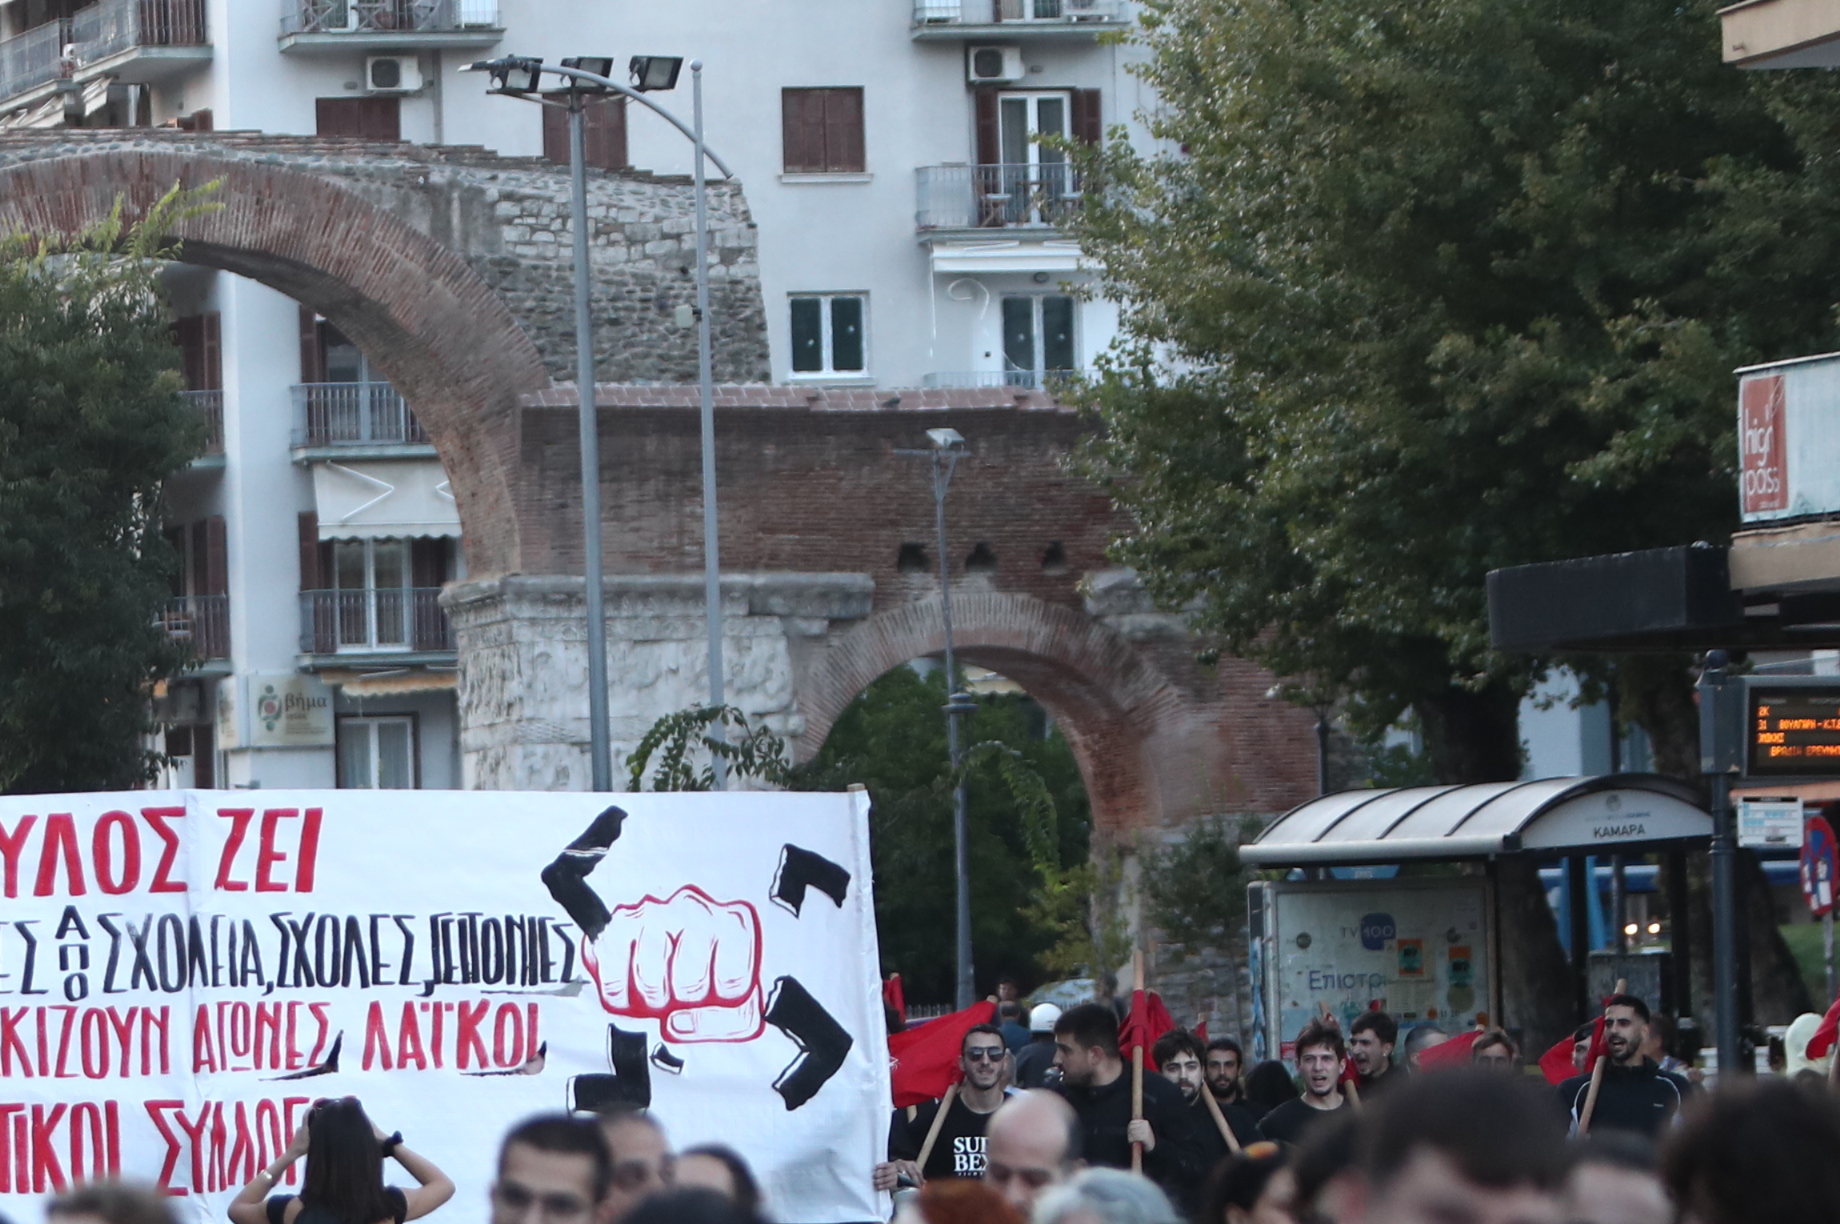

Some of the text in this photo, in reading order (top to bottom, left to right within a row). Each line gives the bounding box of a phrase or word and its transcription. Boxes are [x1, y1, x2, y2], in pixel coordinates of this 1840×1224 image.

[215, 807, 323, 893] ΖΕΙ
[1594, 824, 1645, 838] ΚΑΜΑΡΑ
[1309, 970, 1387, 997] Επιστρ
[193, 1001, 331, 1073] ΑΓΩΝΕΣ
[362, 999, 539, 1071] ΛΑΪΚΟΙ
[145, 1096, 356, 1196] ΣΥΛΛΟΓ
